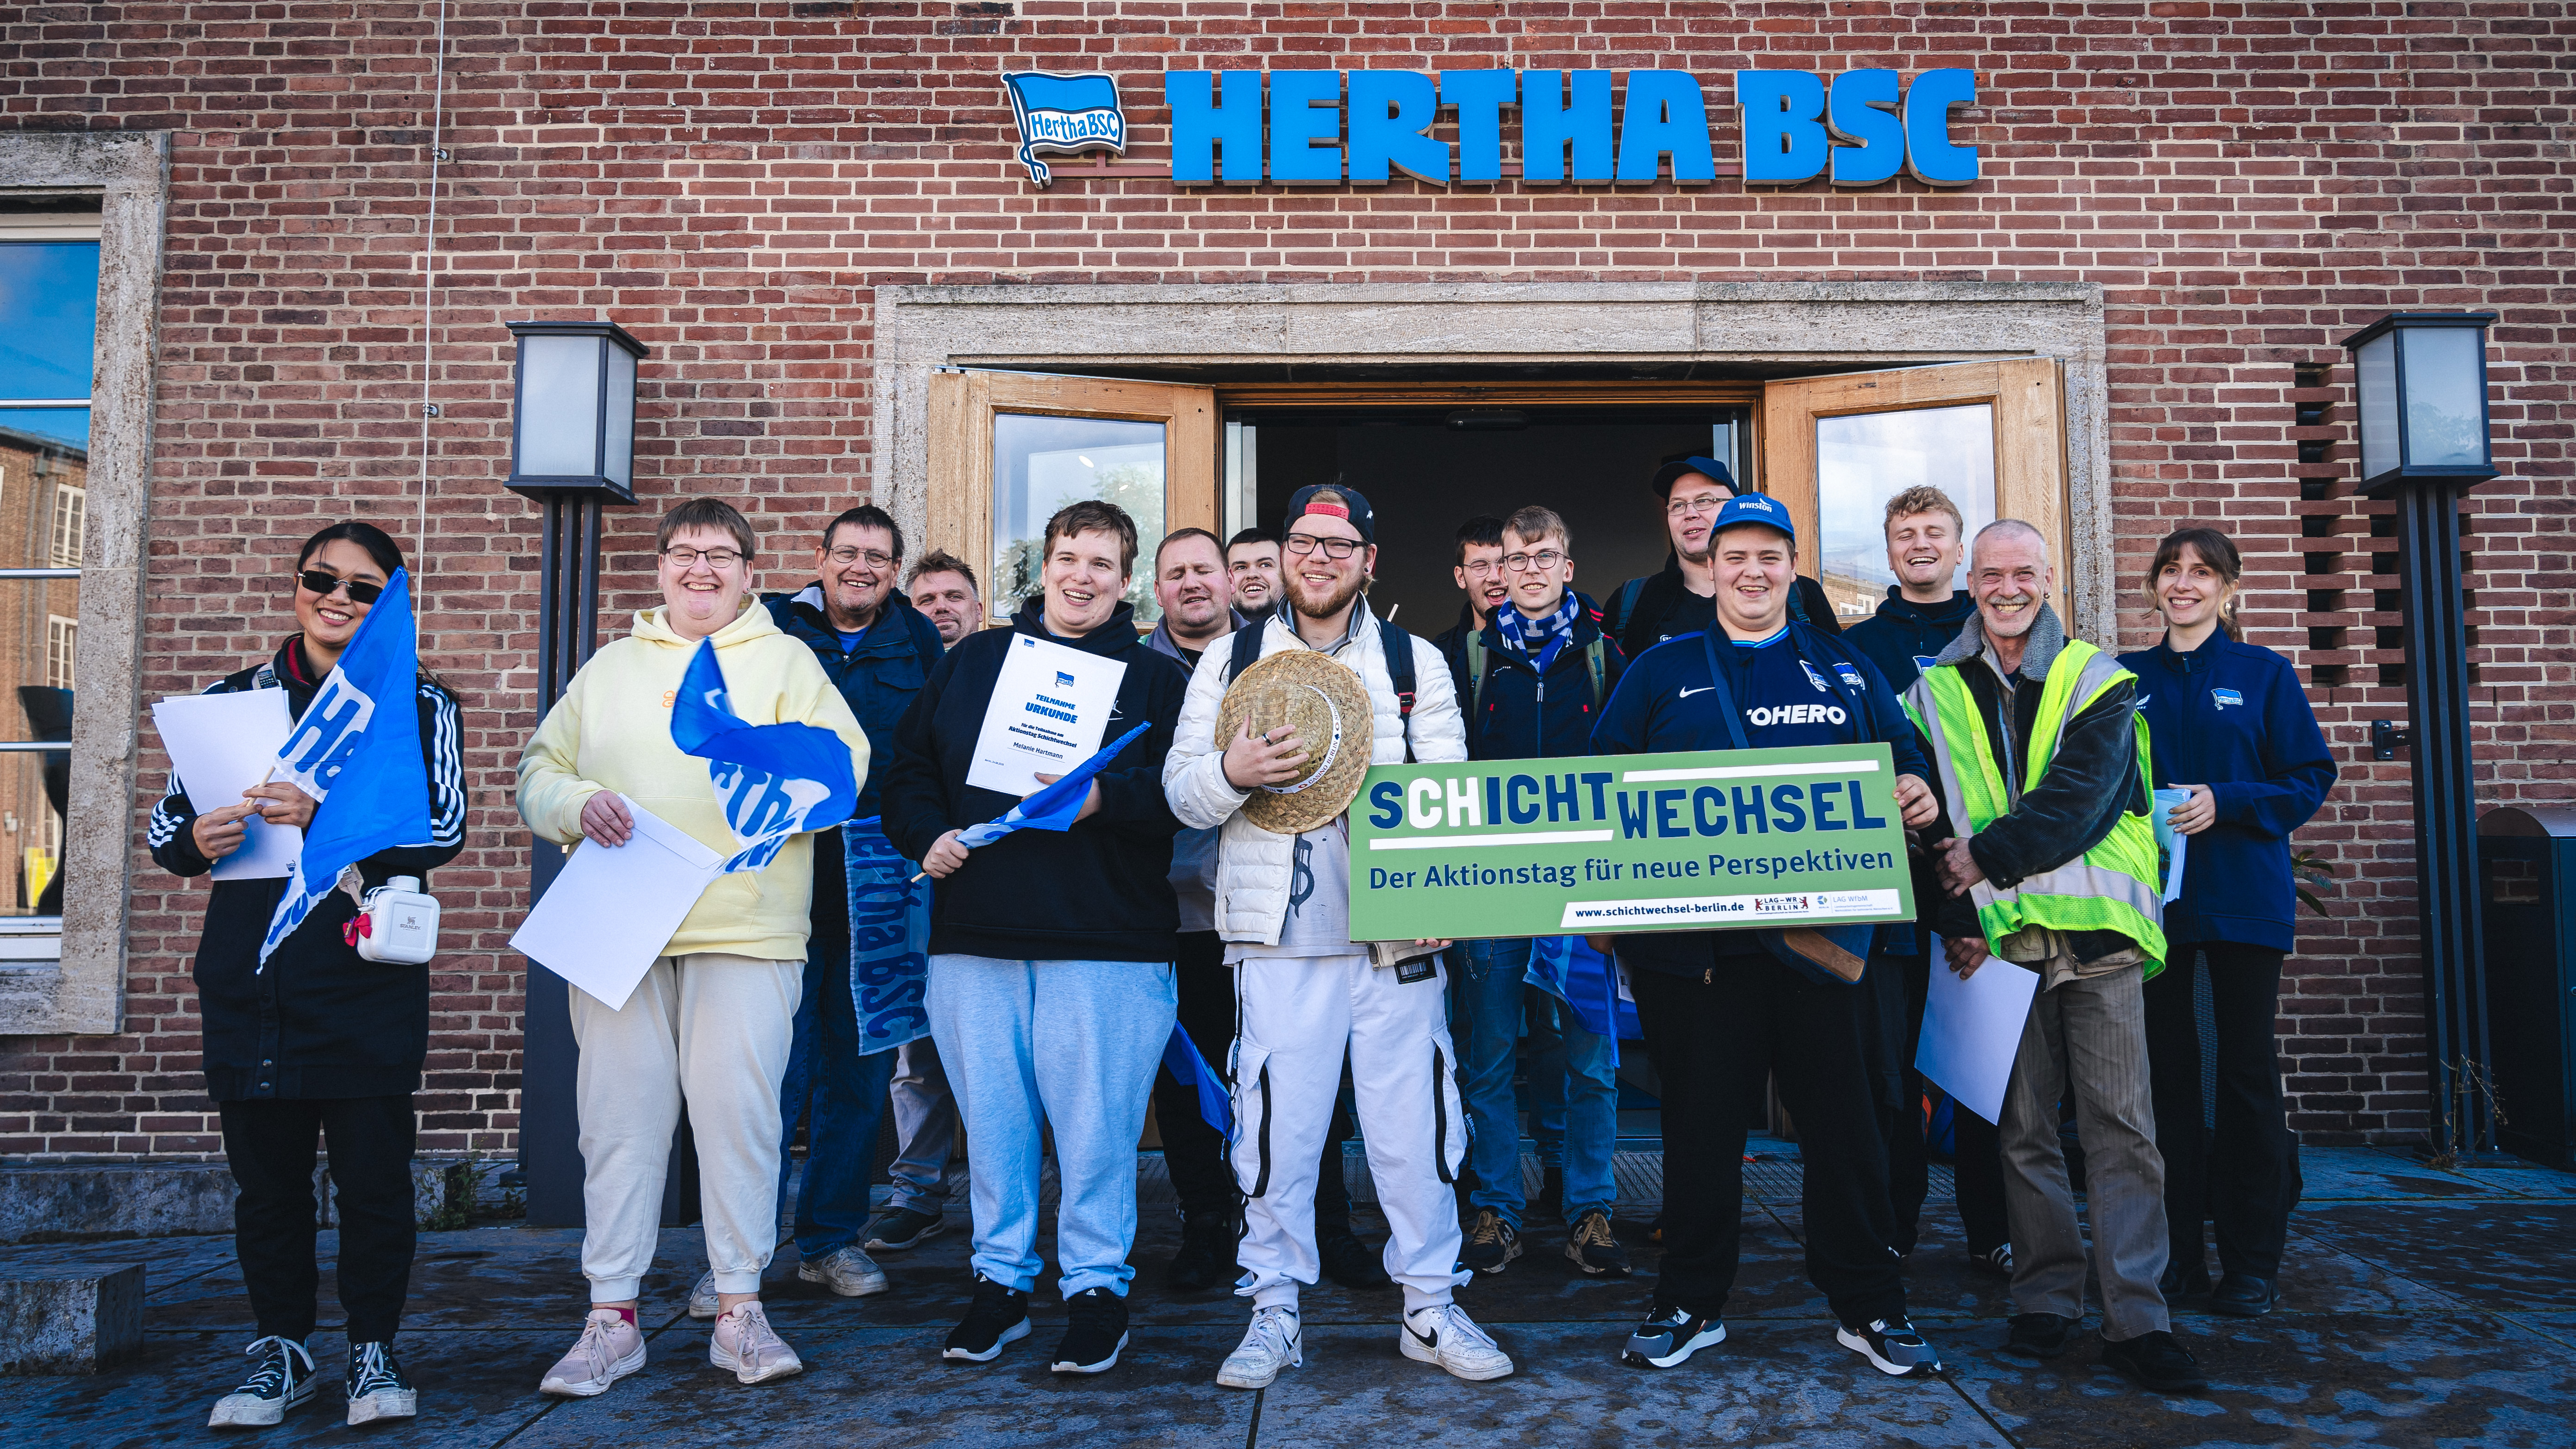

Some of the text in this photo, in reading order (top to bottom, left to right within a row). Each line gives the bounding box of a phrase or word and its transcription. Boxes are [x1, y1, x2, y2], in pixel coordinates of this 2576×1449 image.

[1165, 68, 1979, 185] HERTHA BSC
[1739, 501, 1773, 513] Winston
[1025, 702, 1078, 724] URKUNDE
[1036, 694, 1076, 710] TEILNAHME
[1746, 704, 1846, 726] OHERO
[1008, 726, 1077, 748] Aktionstag Schichtwechsel
[1035, 726, 1059, 735] Teilnahme
[1013, 742, 1063, 759] Melanie Hartmann
[1308, 741, 1338, 784] CASINO BERLIN
[1370, 849, 1893, 889] Der Aktionstag für neue Perspektiven
[1575, 902, 1745, 917] www.schichtwechsel-berlin.de
